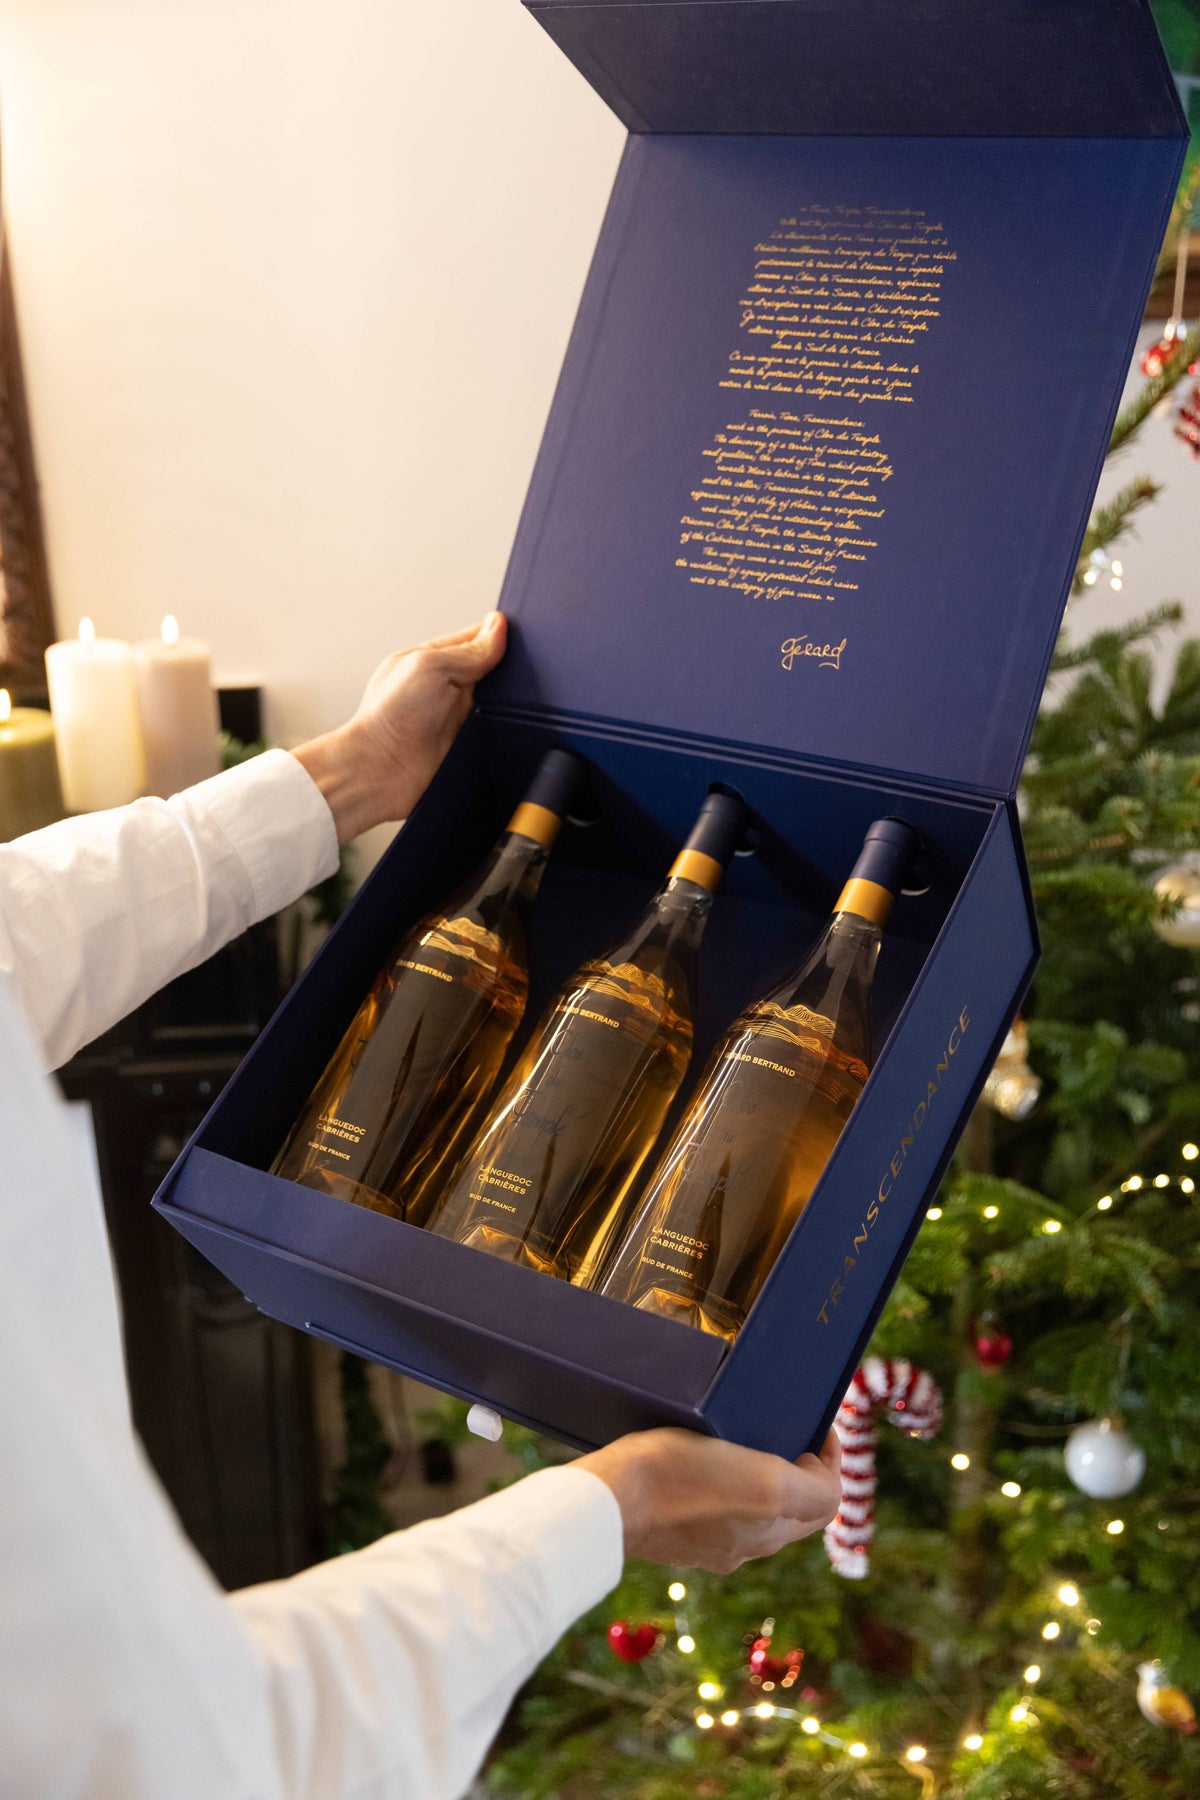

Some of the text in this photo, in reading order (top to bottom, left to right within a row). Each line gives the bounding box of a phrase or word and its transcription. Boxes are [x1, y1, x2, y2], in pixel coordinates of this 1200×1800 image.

[414, 963, 453, 982] BERTRAND
[579, 1008, 620, 1029] BERTRAND
[752, 1056, 796, 1077] BERTRAND
[318, 1114, 366, 1136] LANGUEDOC
[327, 1148, 351, 1161] FRANCE
[816, 1005, 971, 1325] TRANSCENDANCE
[480, 1164, 533, 1187] LANGUEDOC
[469, 1192, 482, 1201] SUD
[491, 1200, 517, 1213] FRANCE
[652, 1225, 710, 1251] LANGUEDOC
[641, 1256, 694, 1279] SUD DE FRANCE
